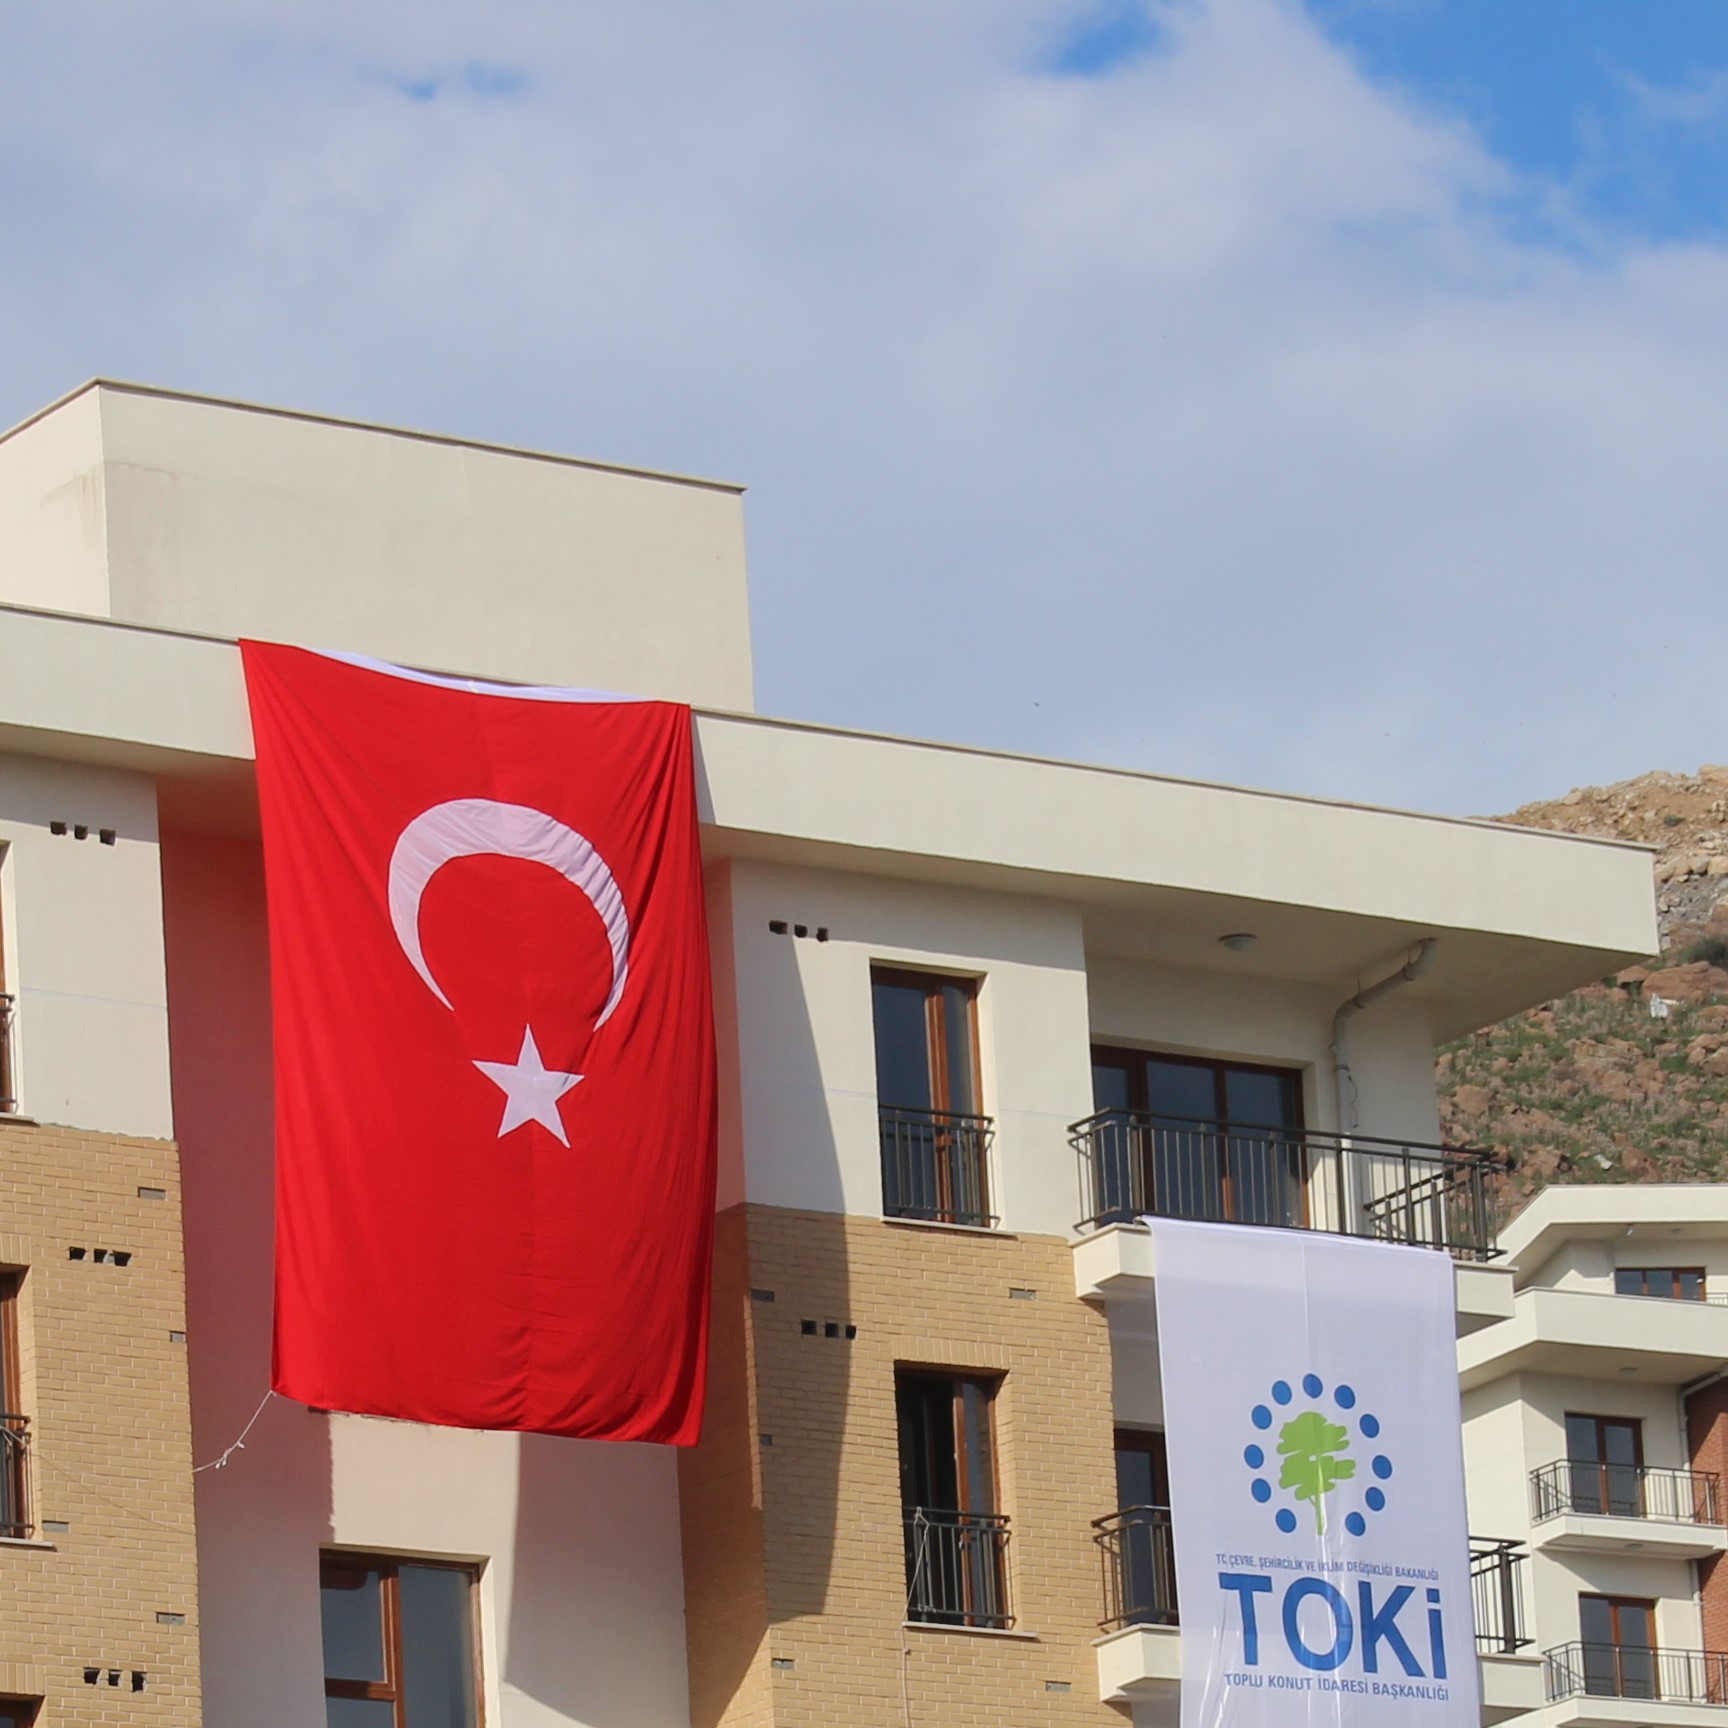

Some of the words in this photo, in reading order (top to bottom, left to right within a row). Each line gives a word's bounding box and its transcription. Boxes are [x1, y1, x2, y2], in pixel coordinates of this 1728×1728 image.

[1304, 1561, 1316, 1572] VE
[1224, 1673, 1263, 1687] TOPLU
[1268, 1675, 1313, 1690] KONUT
[1318, 1674, 1368, 1694] İDARESİ
[1372, 1682, 1449, 1701] BAŞKANLIĞI
